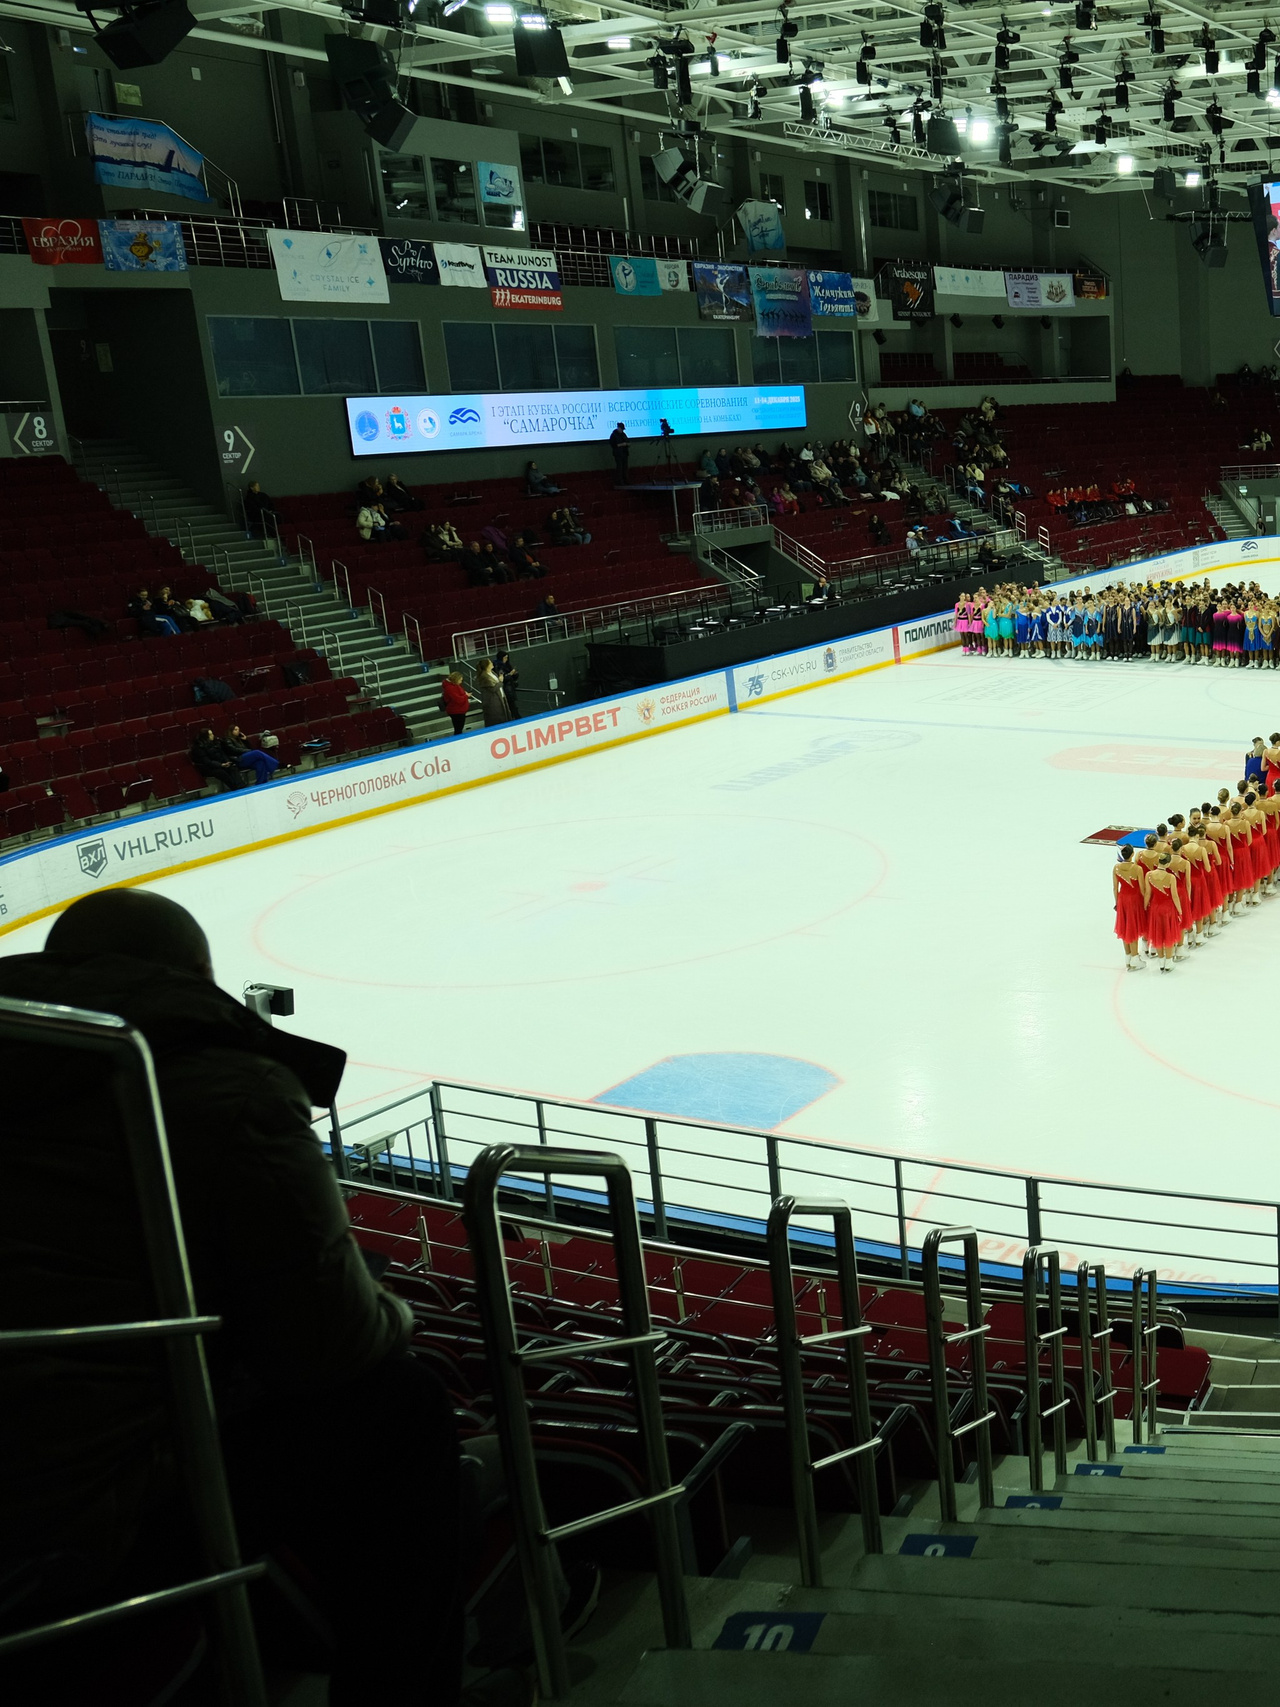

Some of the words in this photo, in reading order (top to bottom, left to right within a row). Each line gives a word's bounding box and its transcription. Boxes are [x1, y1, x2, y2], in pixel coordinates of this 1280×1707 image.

[32, 235, 94, 248] ЕВРАЗИЯ
[388, 245, 434, 274] Synchro
[487, 252, 515, 264] TEAM
[518, 256, 552, 267] JUNOST
[310, 274, 344, 283] CRYSTAL
[496, 269, 553, 289] RUSSIA
[892, 267, 927, 281] Arabesque
[322, 284, 350, 292] FAMILY
[511, 294, 562, 306] EKATERINBURG
[498, 405, 525, 416] ЭТАП
[528, 404, 559, 416] КУБКА
[562, 402, 602, 414] РОССИИ
[685, 397, 748, 409] СОРЕВНОВАНИЯ
[33, 416, 48, 439] 8
[224, 430, 234, 451] 9
[904, 618, 955, 644] ПОЛИПЛАС
[770, 660, 817, 681] CSK-VVS.RU
[659, 687, 701, 705] ФЕДЕРАЦИЯ
[661, 701, 689, 716] ХОККЕЯ
[690, 692, 718, 709] РОССИИ
[490, 706, 621, 760] OLIMPBET
[310, 770, 407, 807] ЧЕРНОГОЛОВКА
[410, 756, 452, 781] Cola
[113, 819, 215, 862] VHLRU.RU
[81, 848, 106, 870] ВХЛ
